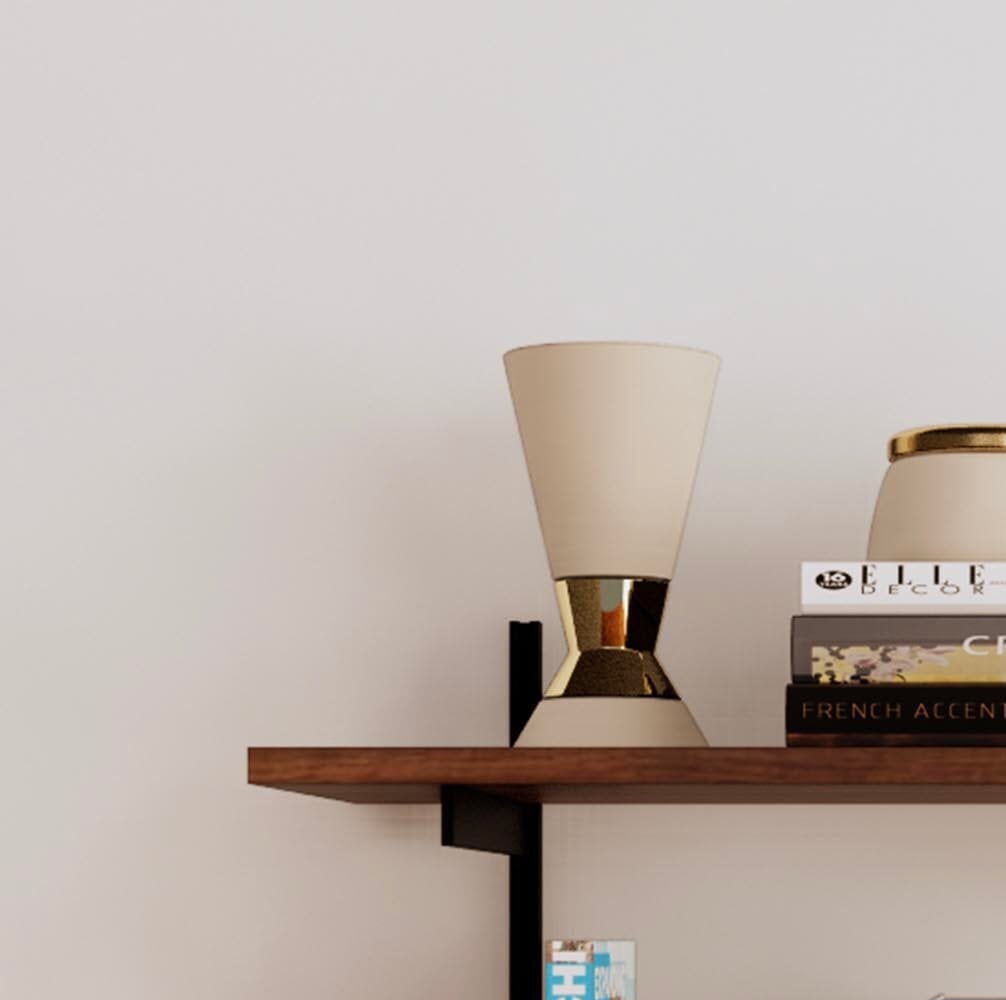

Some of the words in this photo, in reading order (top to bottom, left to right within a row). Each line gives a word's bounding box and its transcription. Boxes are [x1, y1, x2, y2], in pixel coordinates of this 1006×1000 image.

[862, 564, 985, 585] ELLE
[861, 584, 985, 595] DECOR
[801, 702, 902, 719] FRENCH
